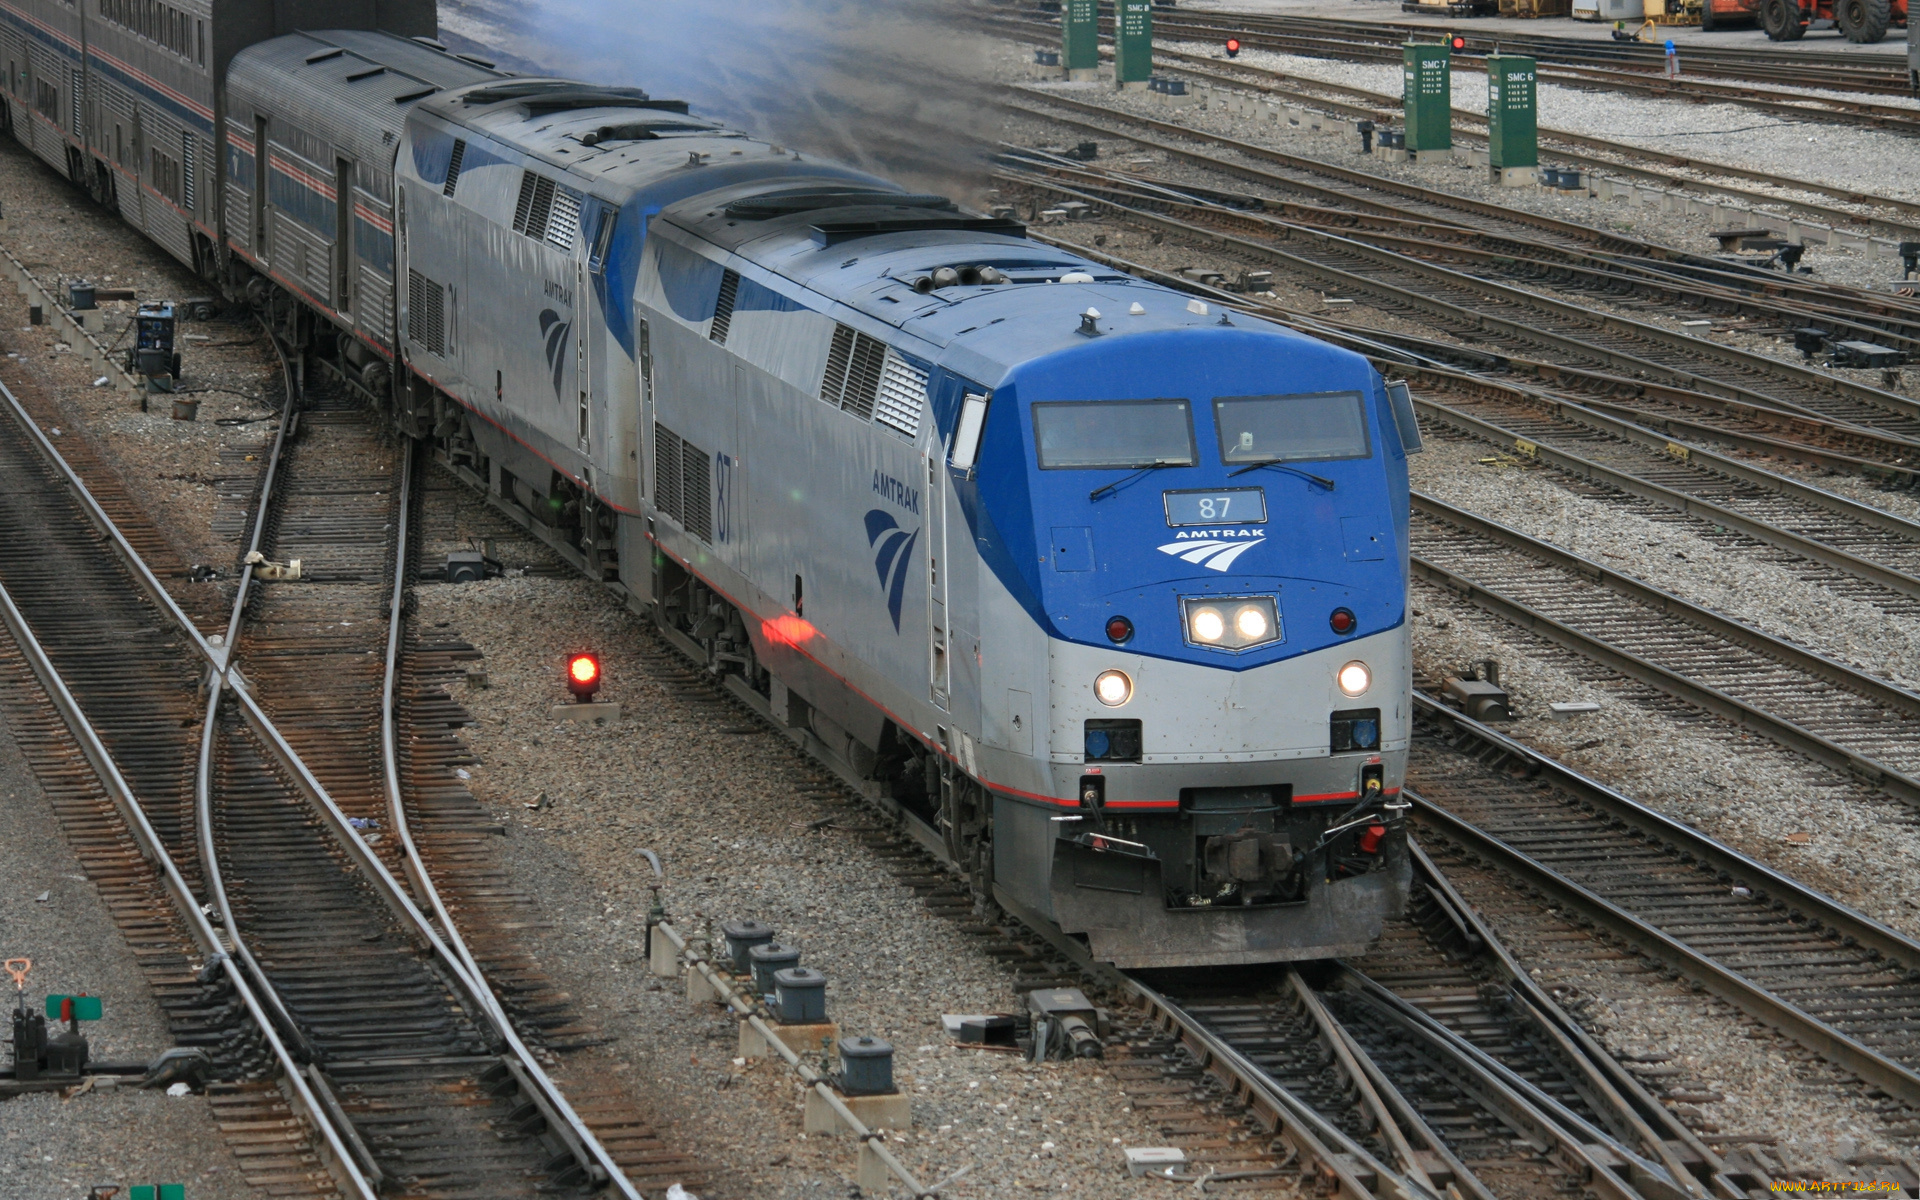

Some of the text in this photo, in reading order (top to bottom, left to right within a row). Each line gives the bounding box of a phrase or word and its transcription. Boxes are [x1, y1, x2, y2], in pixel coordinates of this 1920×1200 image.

[1127, 4, 1143, 12] SMC
[1422, 60, 1447, 69] SMC 7
[1507, 72, 1534, 82] SMC 6
[544, 279, 573, 309] AMTRAK
[716, 451, 731, 545] 87
[872, 468, 919, 515] AMTRAK
[1198, 497, 1231, 519] 87
[1175, 529, 1265, 539] AMTRAK
